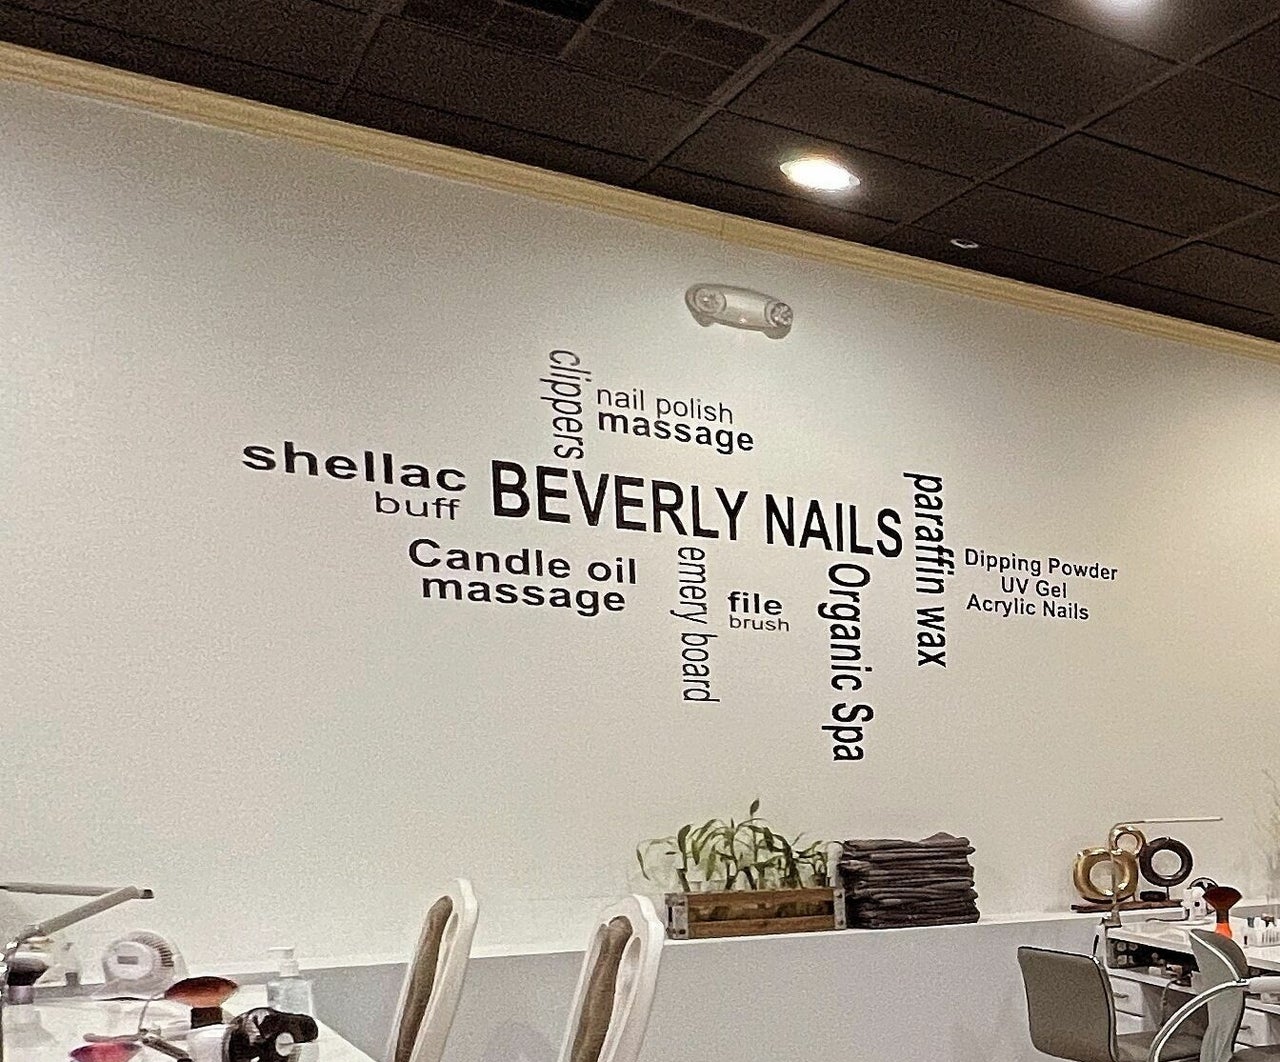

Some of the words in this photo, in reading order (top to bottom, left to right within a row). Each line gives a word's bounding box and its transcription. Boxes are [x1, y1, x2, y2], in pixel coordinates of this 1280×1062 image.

[539, 349, 592, 460] clippers
[597, 388, 645, 412] nail
[656, 397, 734, 425] polish
[598, 411, 754, 456] massage
[242, 440, 467, 492] shellac
[374, 490, 461, 521] buff
[491, 459, 749, 542] BEVERLY
[764, 493, 903, 559] NAILS
[902, 471, 956, 595] paraffin
[408, 538, 571, 581] Candle
[587, 558, 637, 586] oil
[669, 546, 708, 625] emery
[964, 547, 1042, 577] Dipping
[1048, 557, 1118, 581] Powder
[422, 577, 626, 618] massage
[727, 590, 783, 616] file
[966, 593, 1036, 618] Acrylic
[1042, 600, 1090, 621] Nails
[1001, 575, 1030, 595] UV
[1035, 579, 1067, 599] Gel
[729, 614, 790, 632] brush
[817, 562, 874, 692] Organic
[916, 606, 947, 668] wax
[680, 632, 721, 703] board
[820, 702, 875, 762] Spa
